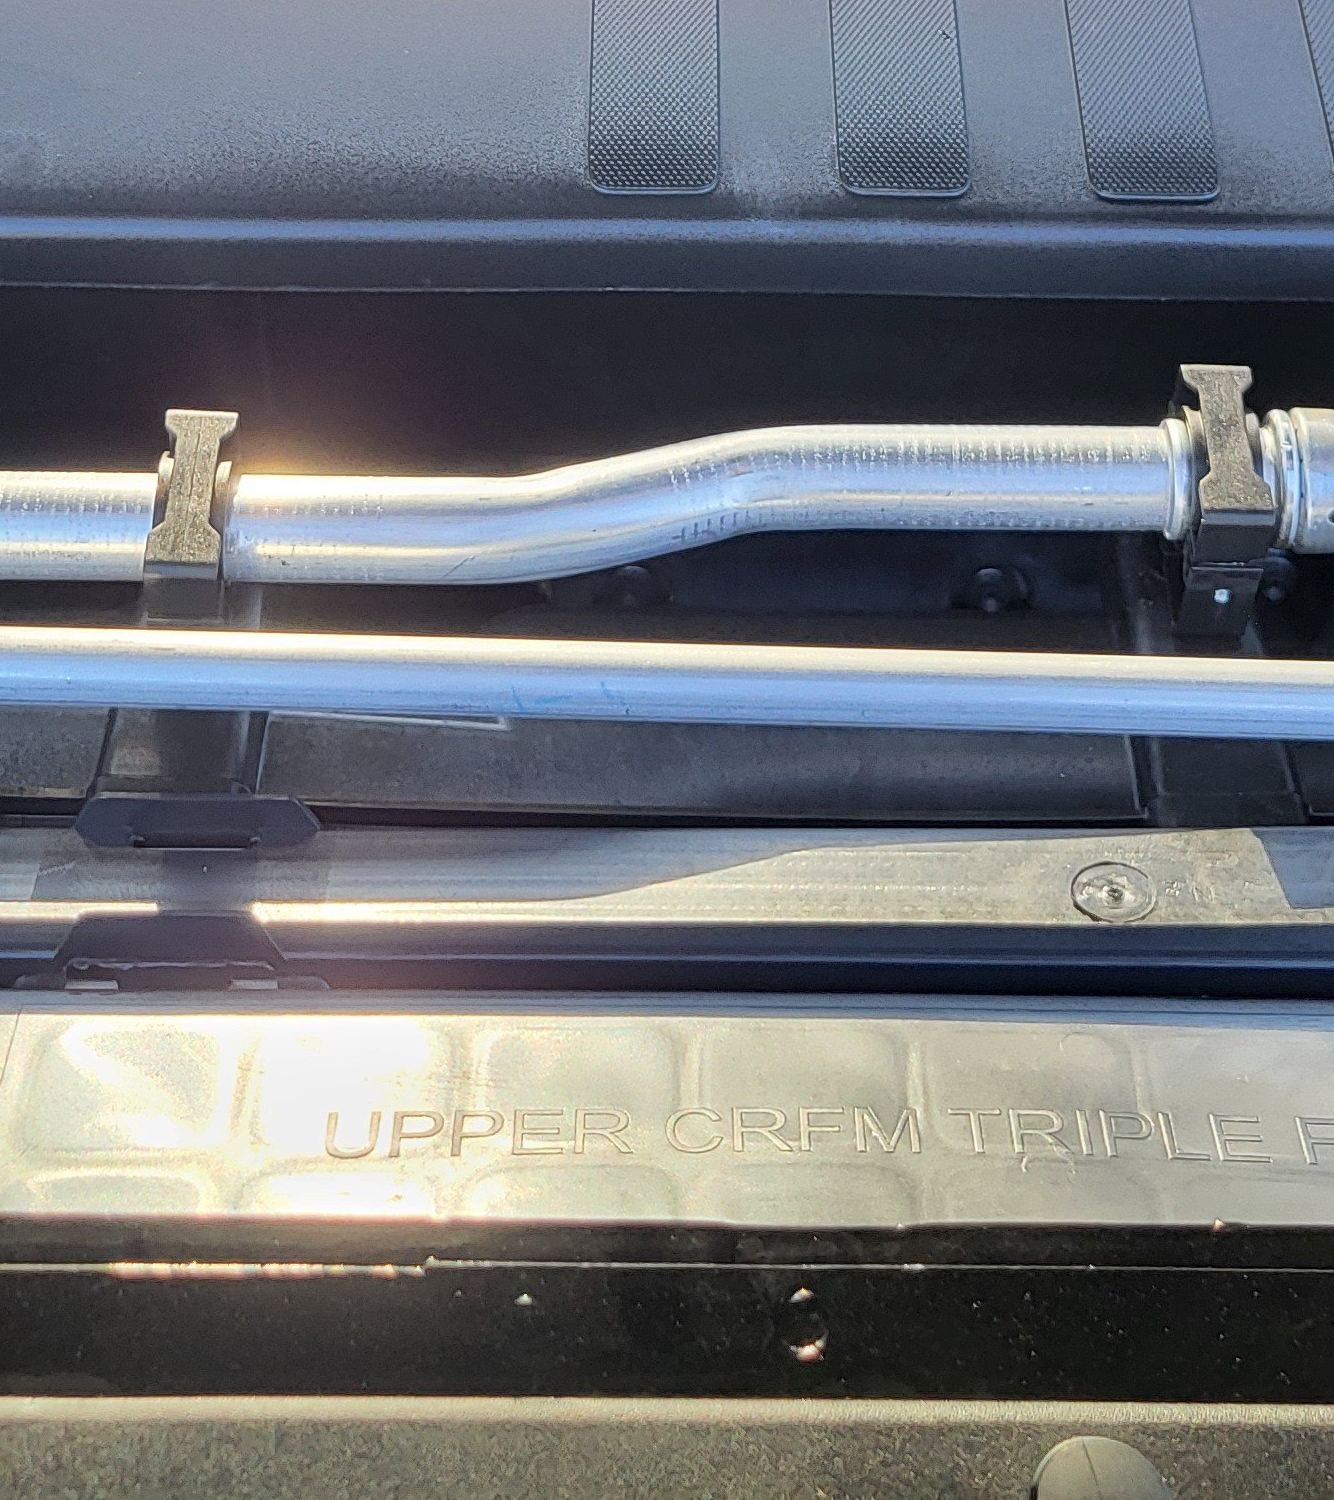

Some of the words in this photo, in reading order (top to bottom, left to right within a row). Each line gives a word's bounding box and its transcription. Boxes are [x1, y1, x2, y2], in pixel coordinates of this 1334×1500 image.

[323, 1106, 635, 1159] UPPER
[665, 1105, 922, 1155] CRFM
[947, 1107, 1274, 1164] TRIPLE
